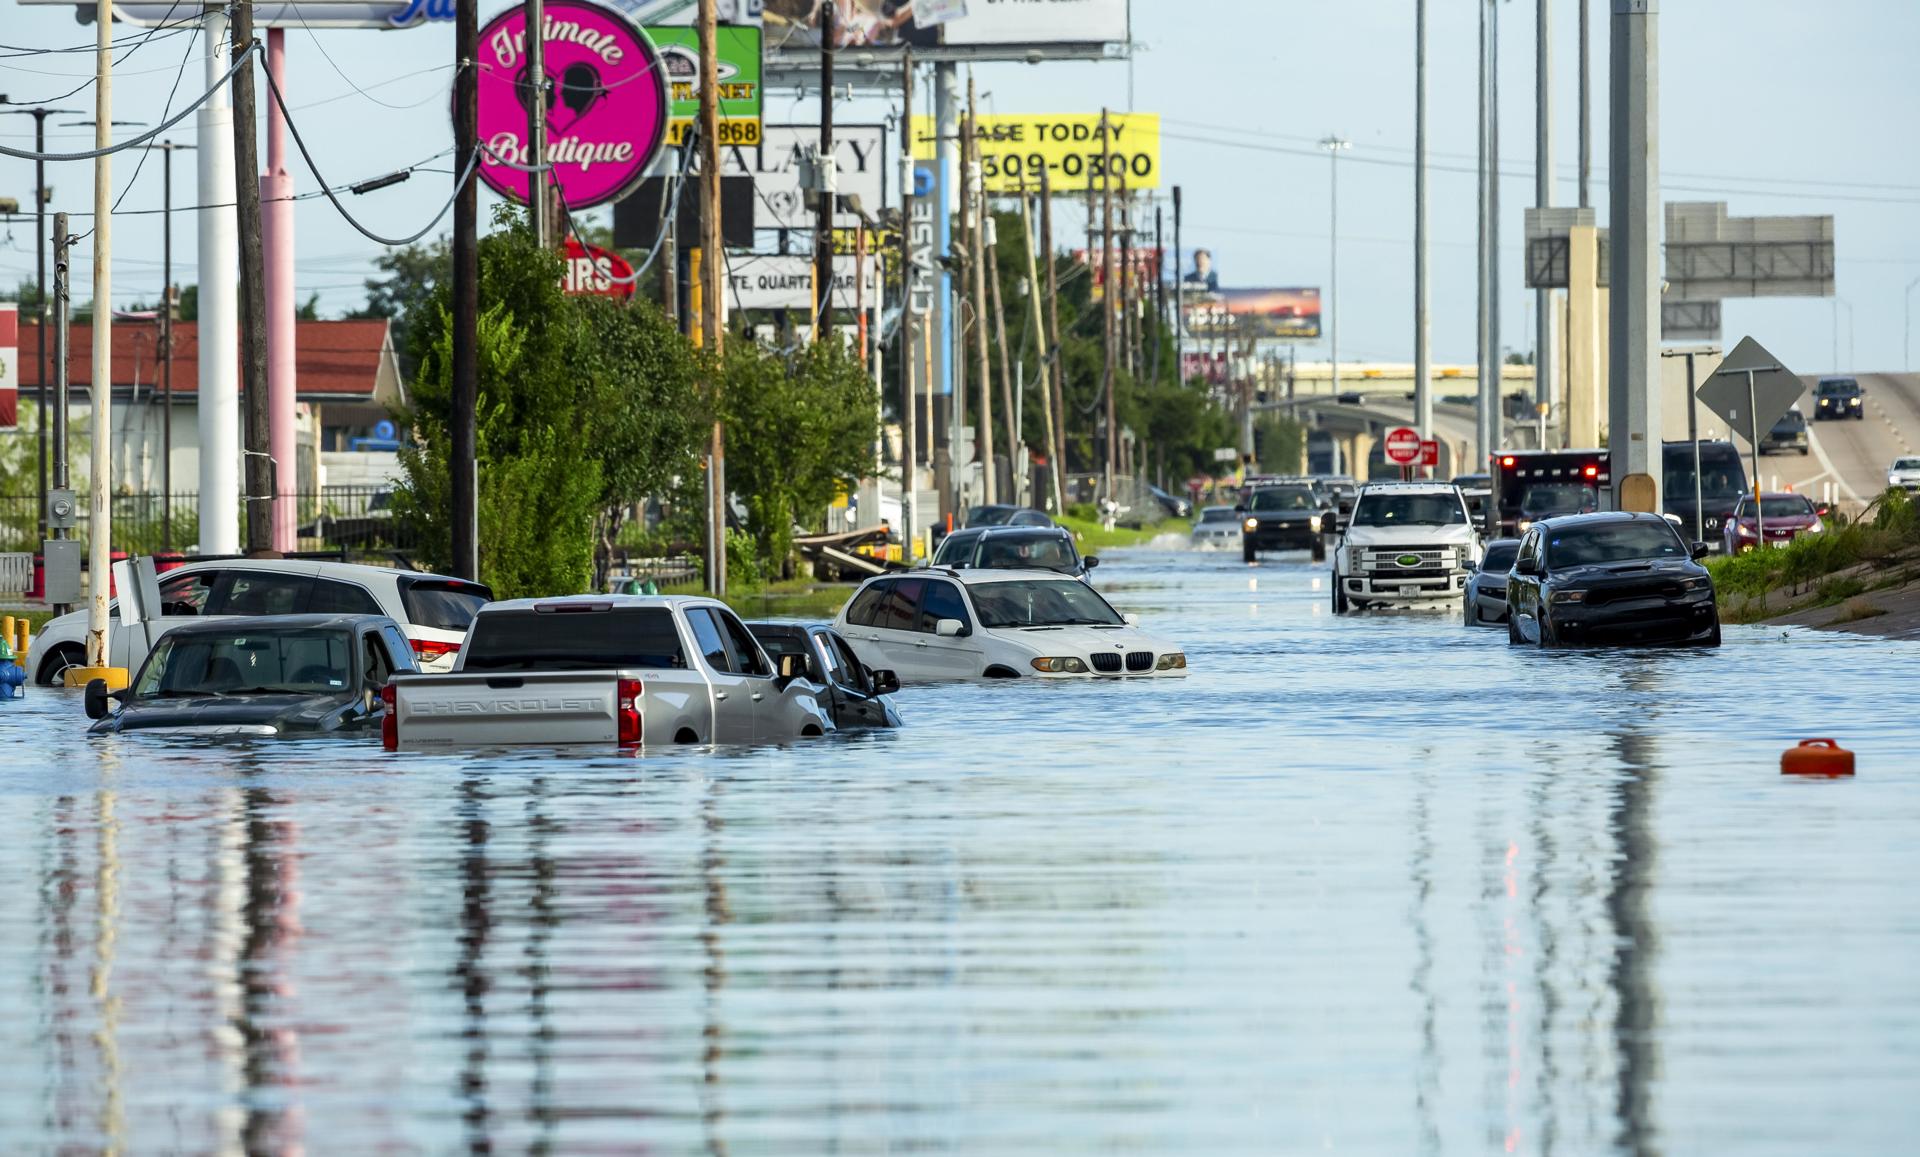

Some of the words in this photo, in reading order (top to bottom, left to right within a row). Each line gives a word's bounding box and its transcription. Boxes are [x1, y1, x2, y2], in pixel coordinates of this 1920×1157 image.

[491, 15, 623, 68] Inimate
[671, 82, 755, 99] PLNET
[1034, 123, 1124, 141] TODAY
[910, 202, 934, 316] CHASE
[566, 257, 612, 291] IRS
[410, 698, 602, 714] CHEVROLET
